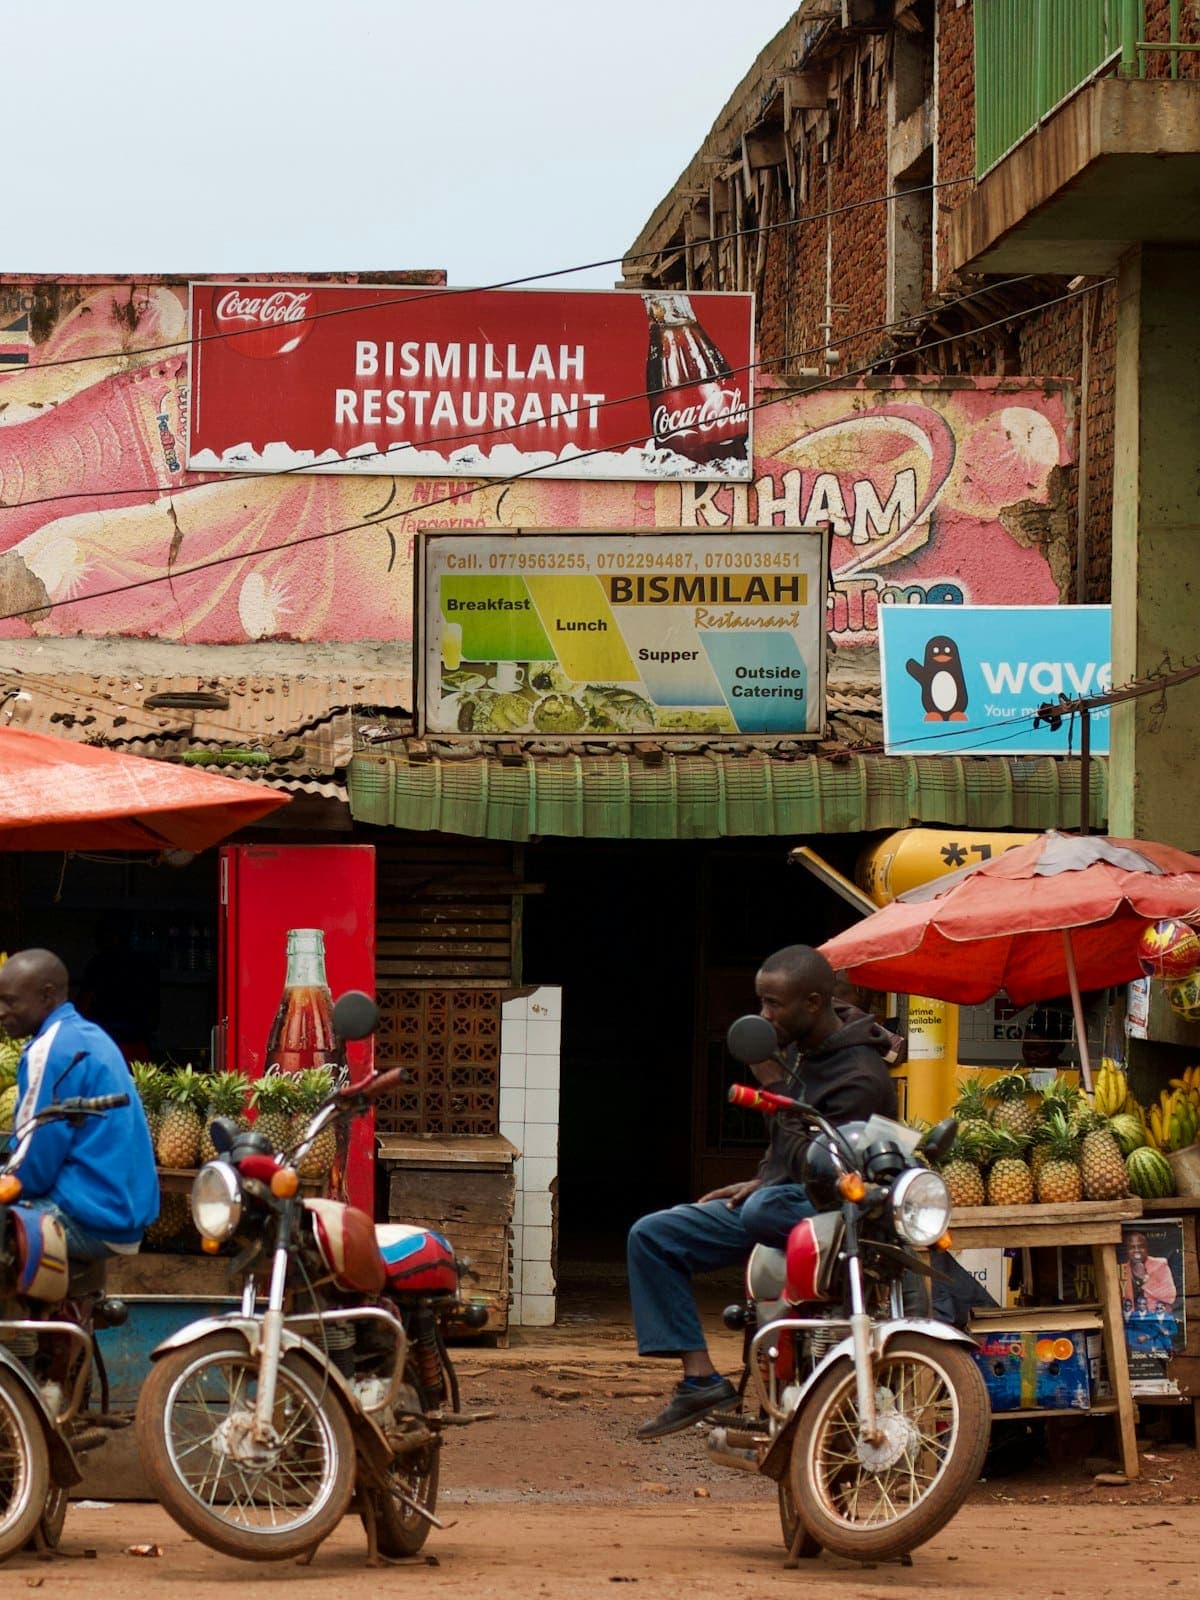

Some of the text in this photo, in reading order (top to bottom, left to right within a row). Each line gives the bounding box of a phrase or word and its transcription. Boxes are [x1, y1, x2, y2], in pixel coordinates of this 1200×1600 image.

[216, 290, 312, 322] Coca-Cola
[355, 341, 585, 381] BISMILLAH
[335, 388, 605, 429] RESTAURANT
[446, 553, 800, 571] Call. 0779563255, 0702294487, 0703038451
[609, 576, 800, 603] BISMILAH
[446, 597, 531, 612] Breakfast
[555, 618, 608, 633] Lunch
[693, 606, 801, 630] Restaurant
[638, 647, 700, 664] Supper
[734, 665, 801, 680] Outside
[731, 684, 804, 701] Catering
[984, 704, 1017, 718] Your
